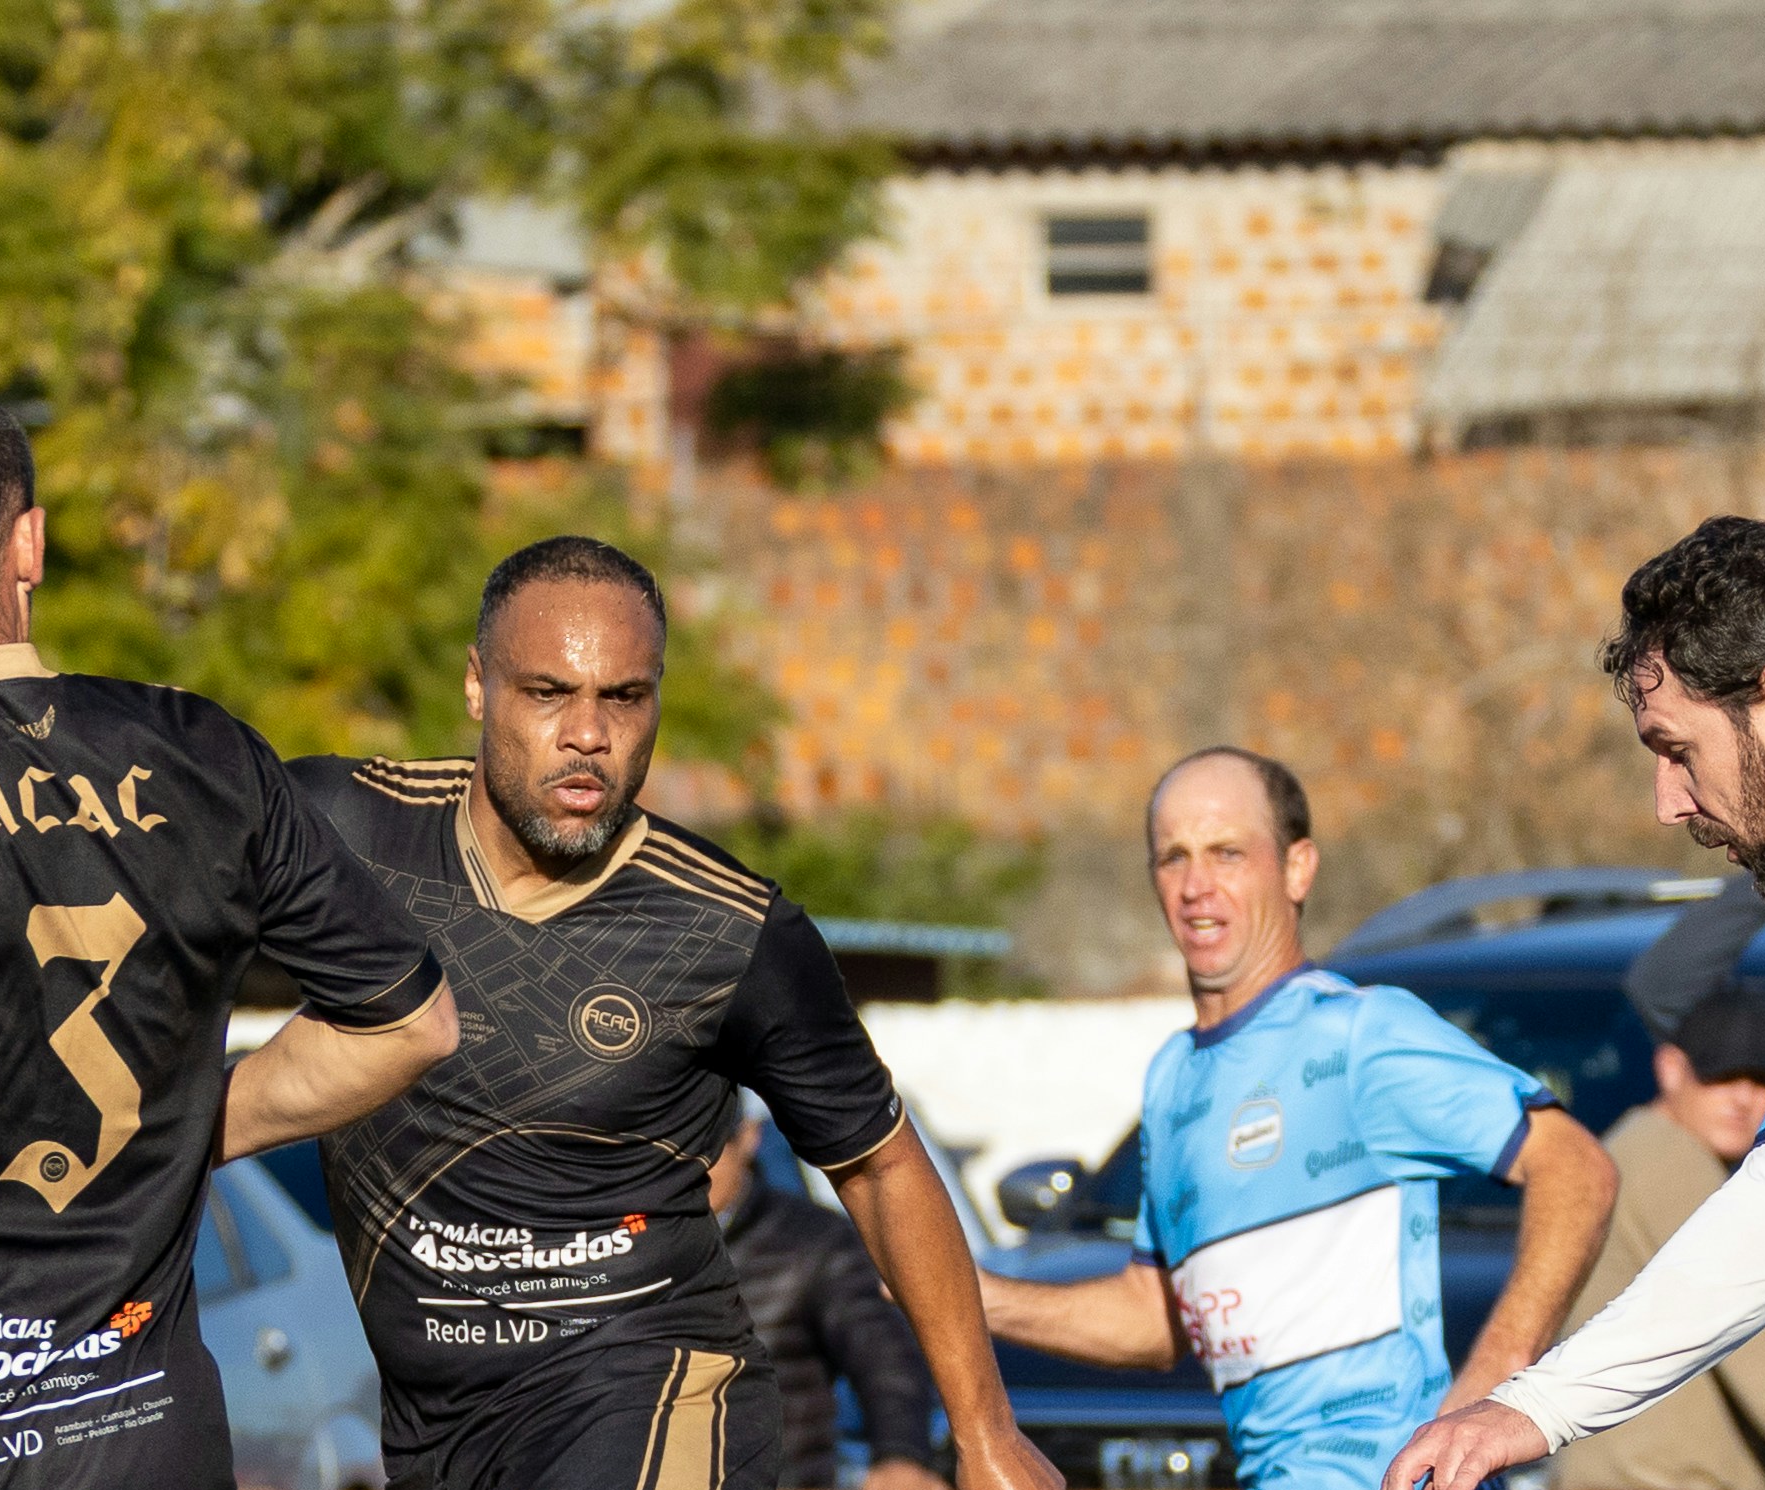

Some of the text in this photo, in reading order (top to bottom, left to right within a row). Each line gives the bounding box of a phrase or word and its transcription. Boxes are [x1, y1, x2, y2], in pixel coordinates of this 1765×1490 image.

[586, 1008, 636, 1033] ACAC
[411, 1228, 633, 1272] Associadas
[514, 1278, 546, 1293] tem
[425, 1317, 549, 1345] Rede LVD
[40, 1372, 100, 1391] amigos.
